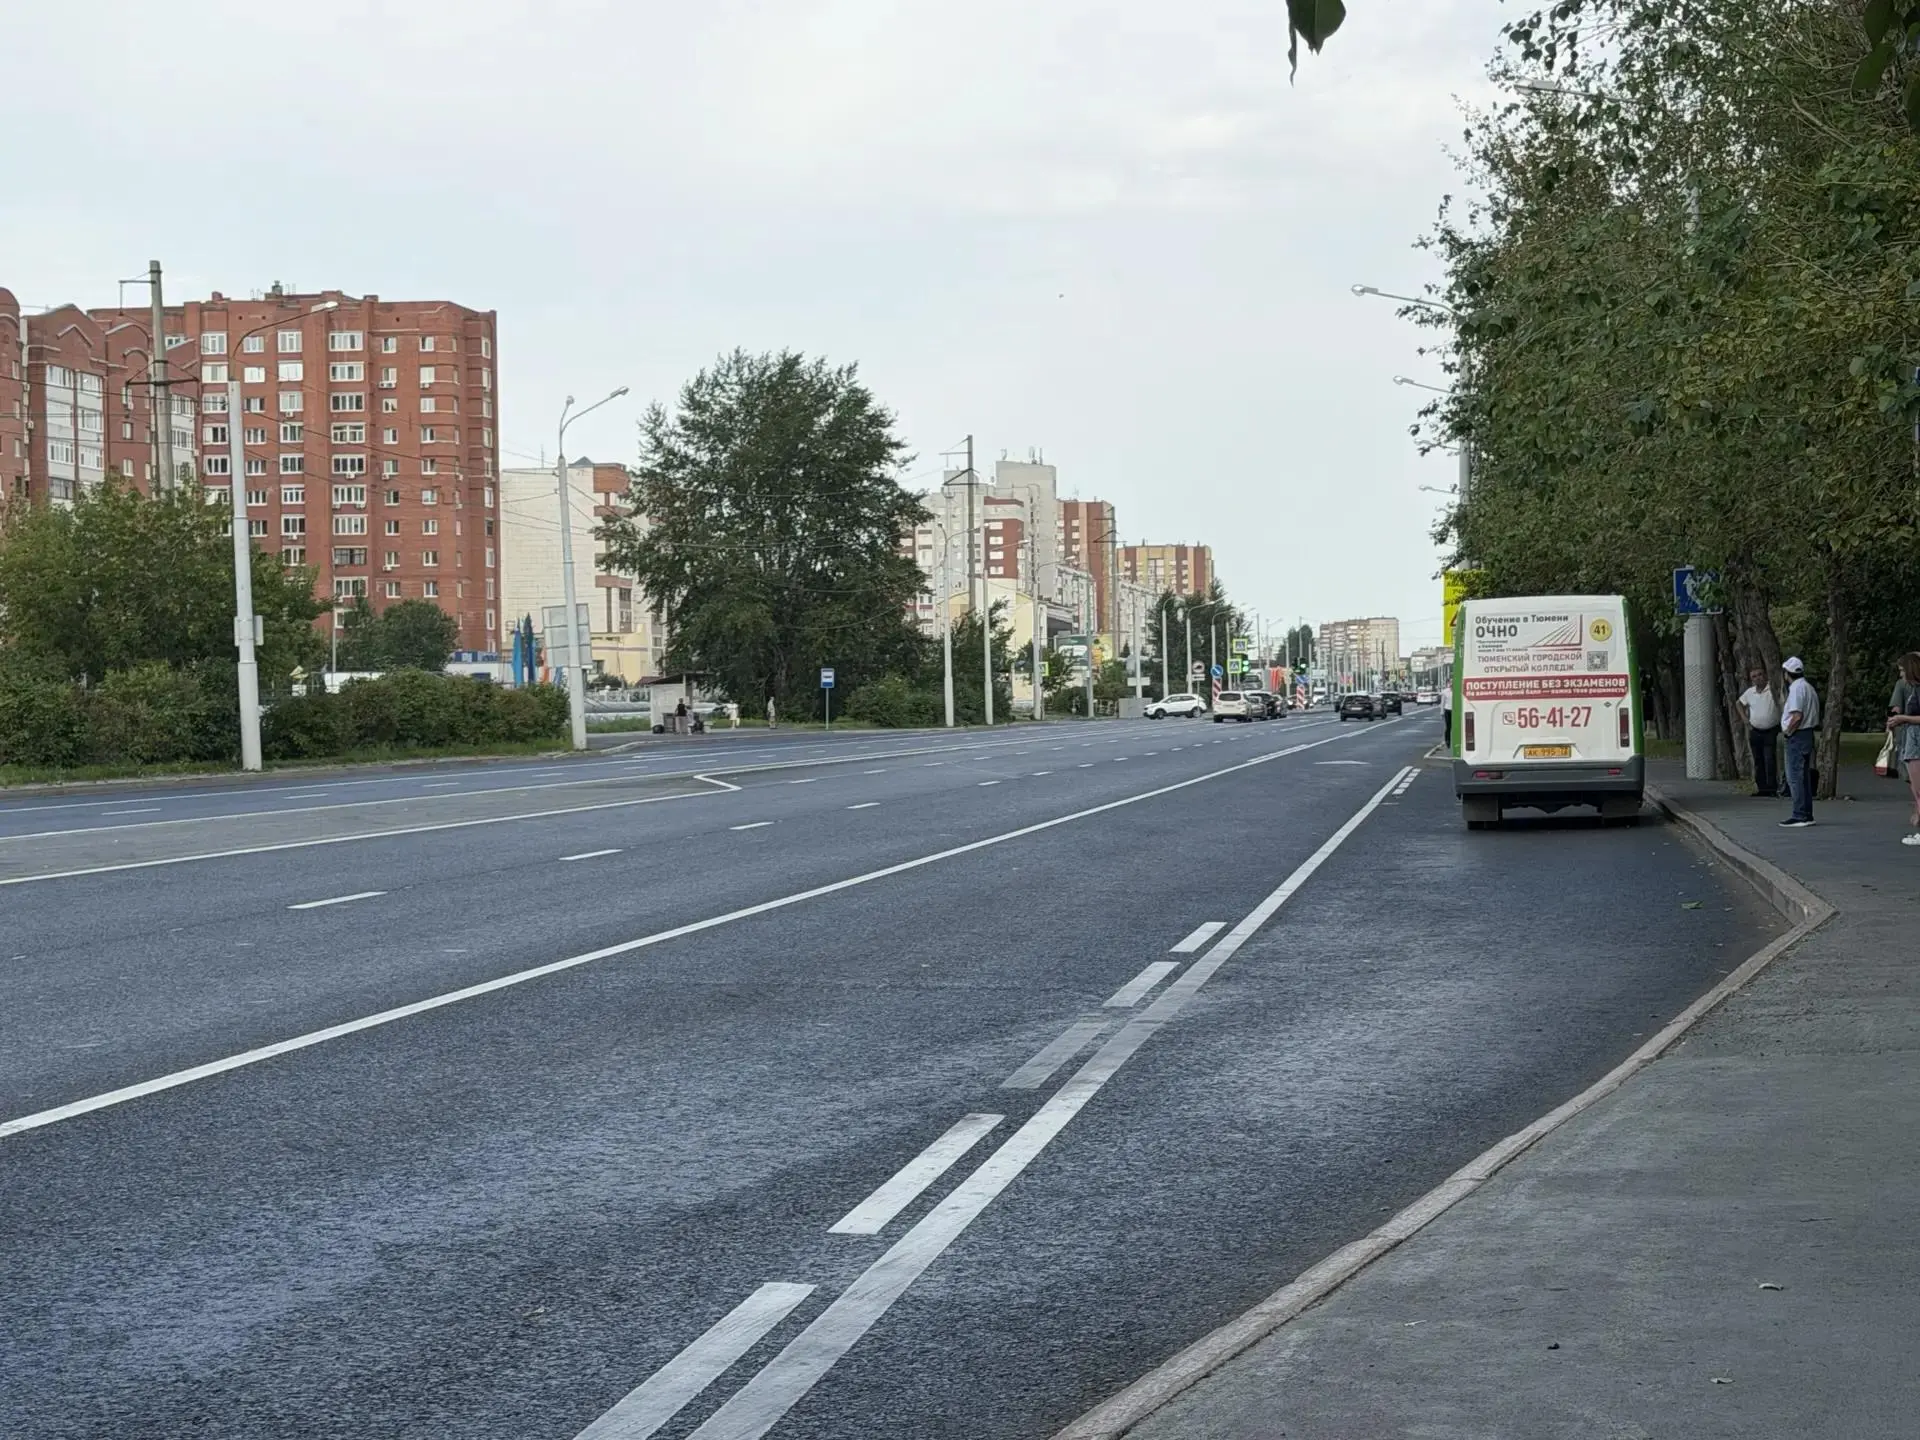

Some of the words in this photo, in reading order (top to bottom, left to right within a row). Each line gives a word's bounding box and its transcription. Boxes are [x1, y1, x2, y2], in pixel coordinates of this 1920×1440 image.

[1475, 616, 1521, 625] Обучение
[1531, 614, 1569, 623] Тюмени
[1475, 625, 1518, 638] ОЧНО
[1594, 625, 1606, 635] 41
[1477, 653, 1530, 663] ТЮМЕНСКИЙ
[1532, 651, 1583, 662] ГОРОДСКОЙ
[1484, 663, 1530, 673] ОТКРЫТЫЙ
[1531, 663, 1575, 672] КОЛЛЕДЖ
[1465, 680, 1541, 691] ПОСТУПЛЕНИЕ
[1541, 679, 1562, 689] БЕЗ
[1563, 678, 1626, 688] ЭКЗАМЕНОВ
[1517, 706, 1592, 728] 56-41-27
